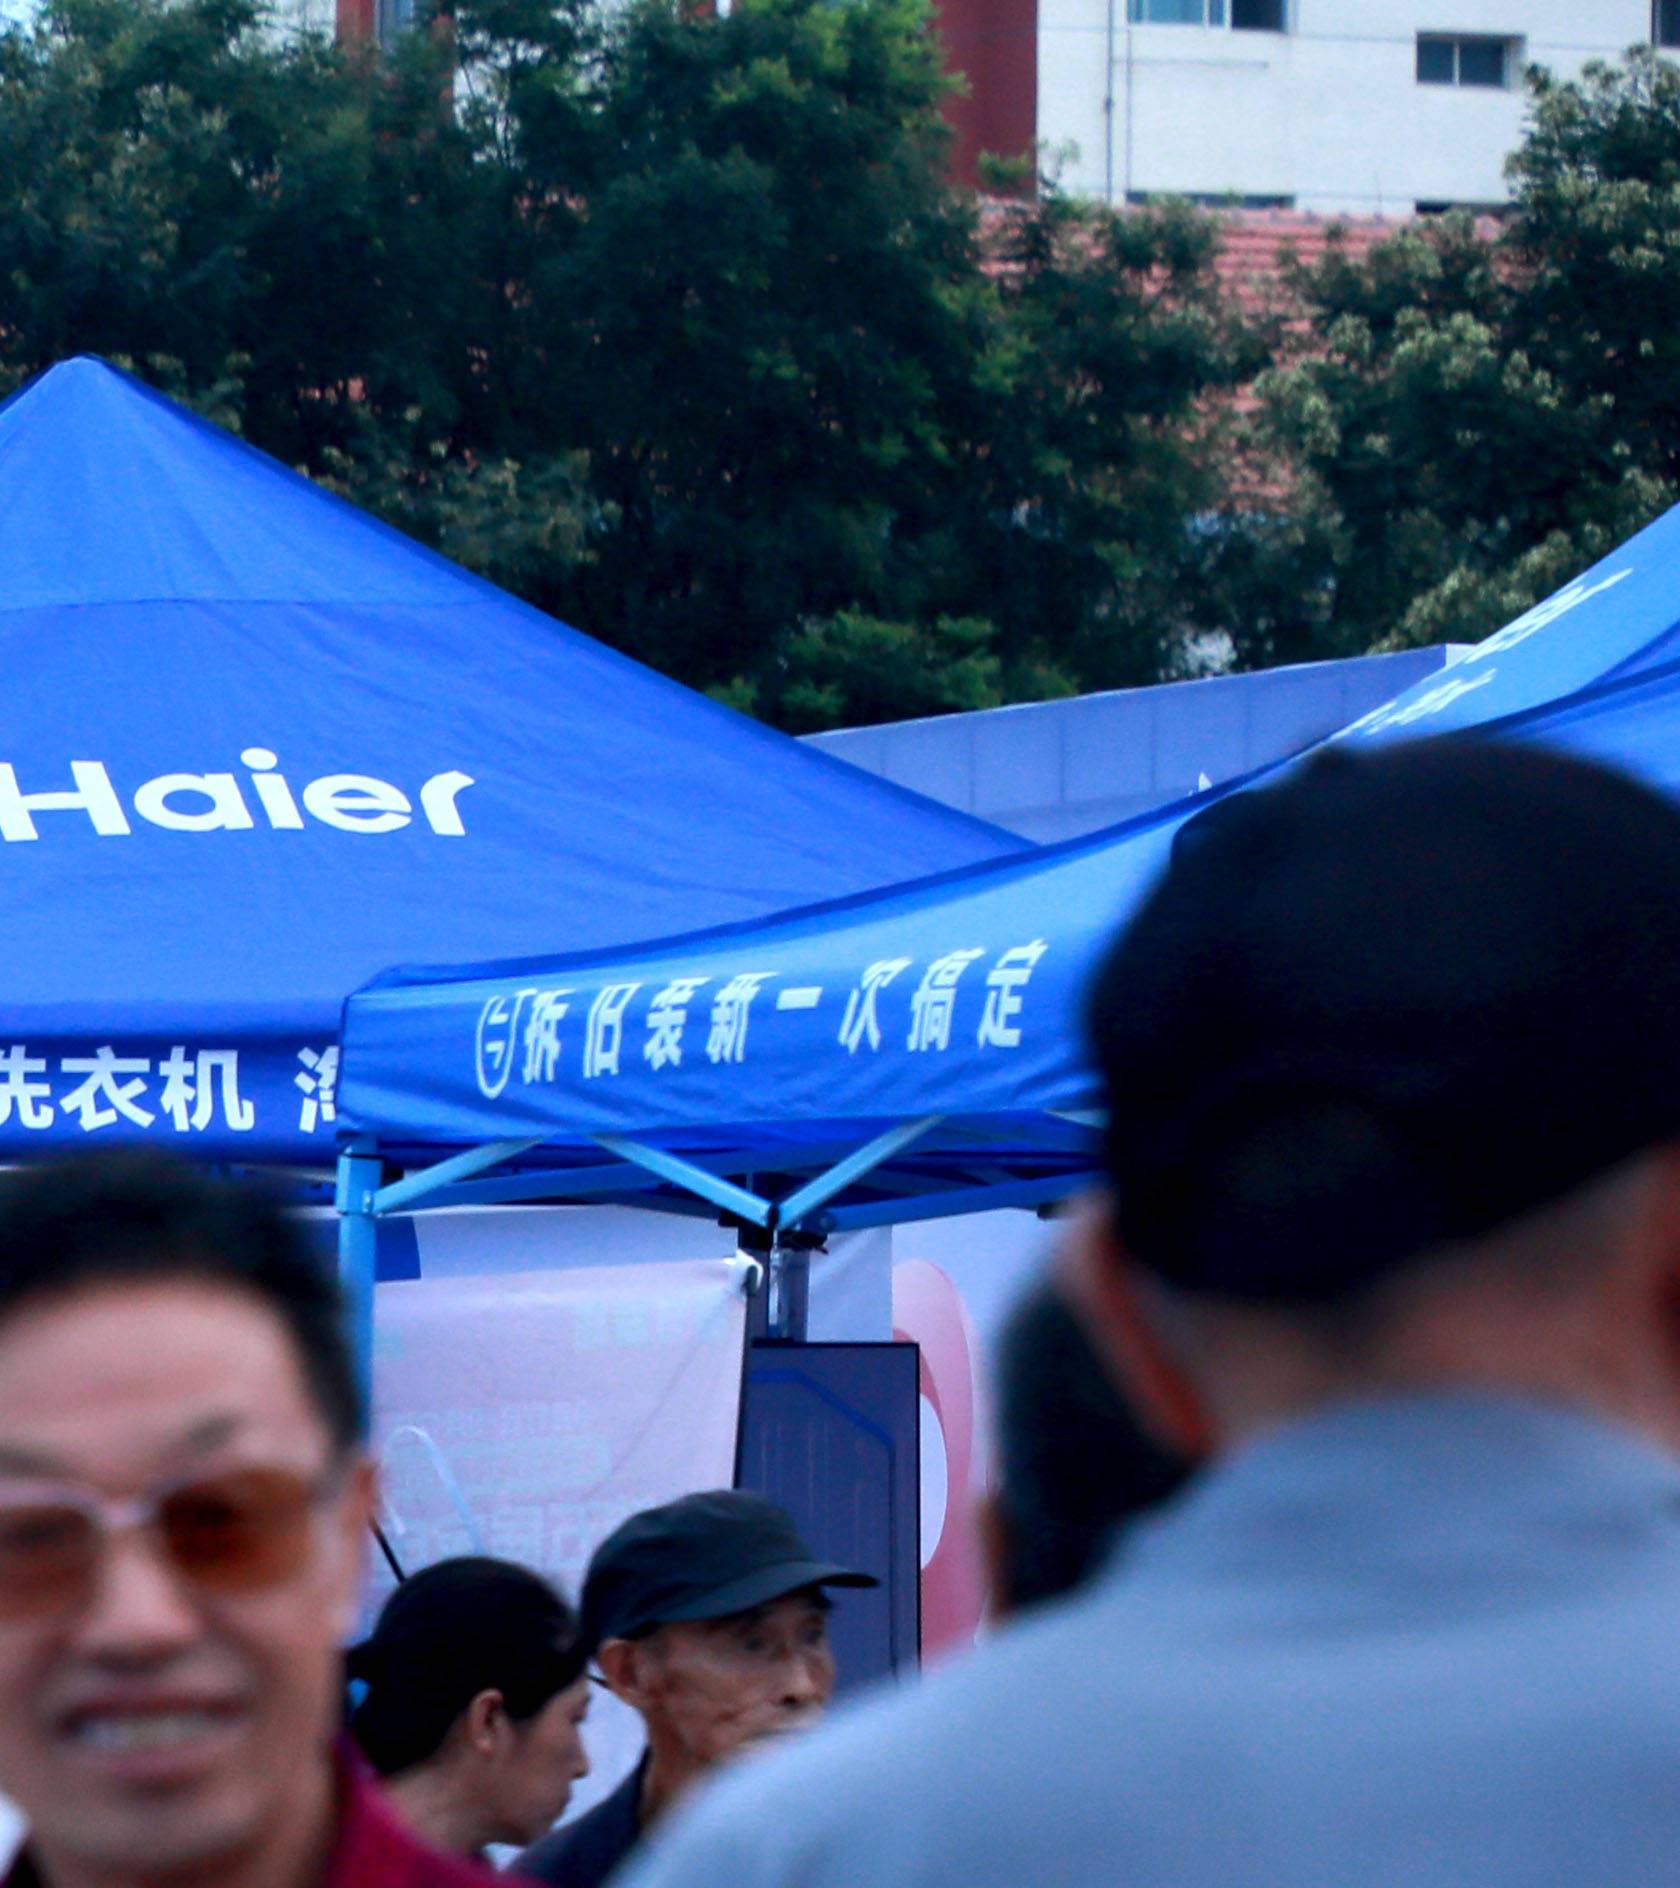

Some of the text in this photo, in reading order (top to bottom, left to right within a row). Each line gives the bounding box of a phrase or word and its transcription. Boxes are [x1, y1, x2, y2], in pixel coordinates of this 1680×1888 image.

[522, 939, 1048, 1084] 拆旧装新一次搞定
